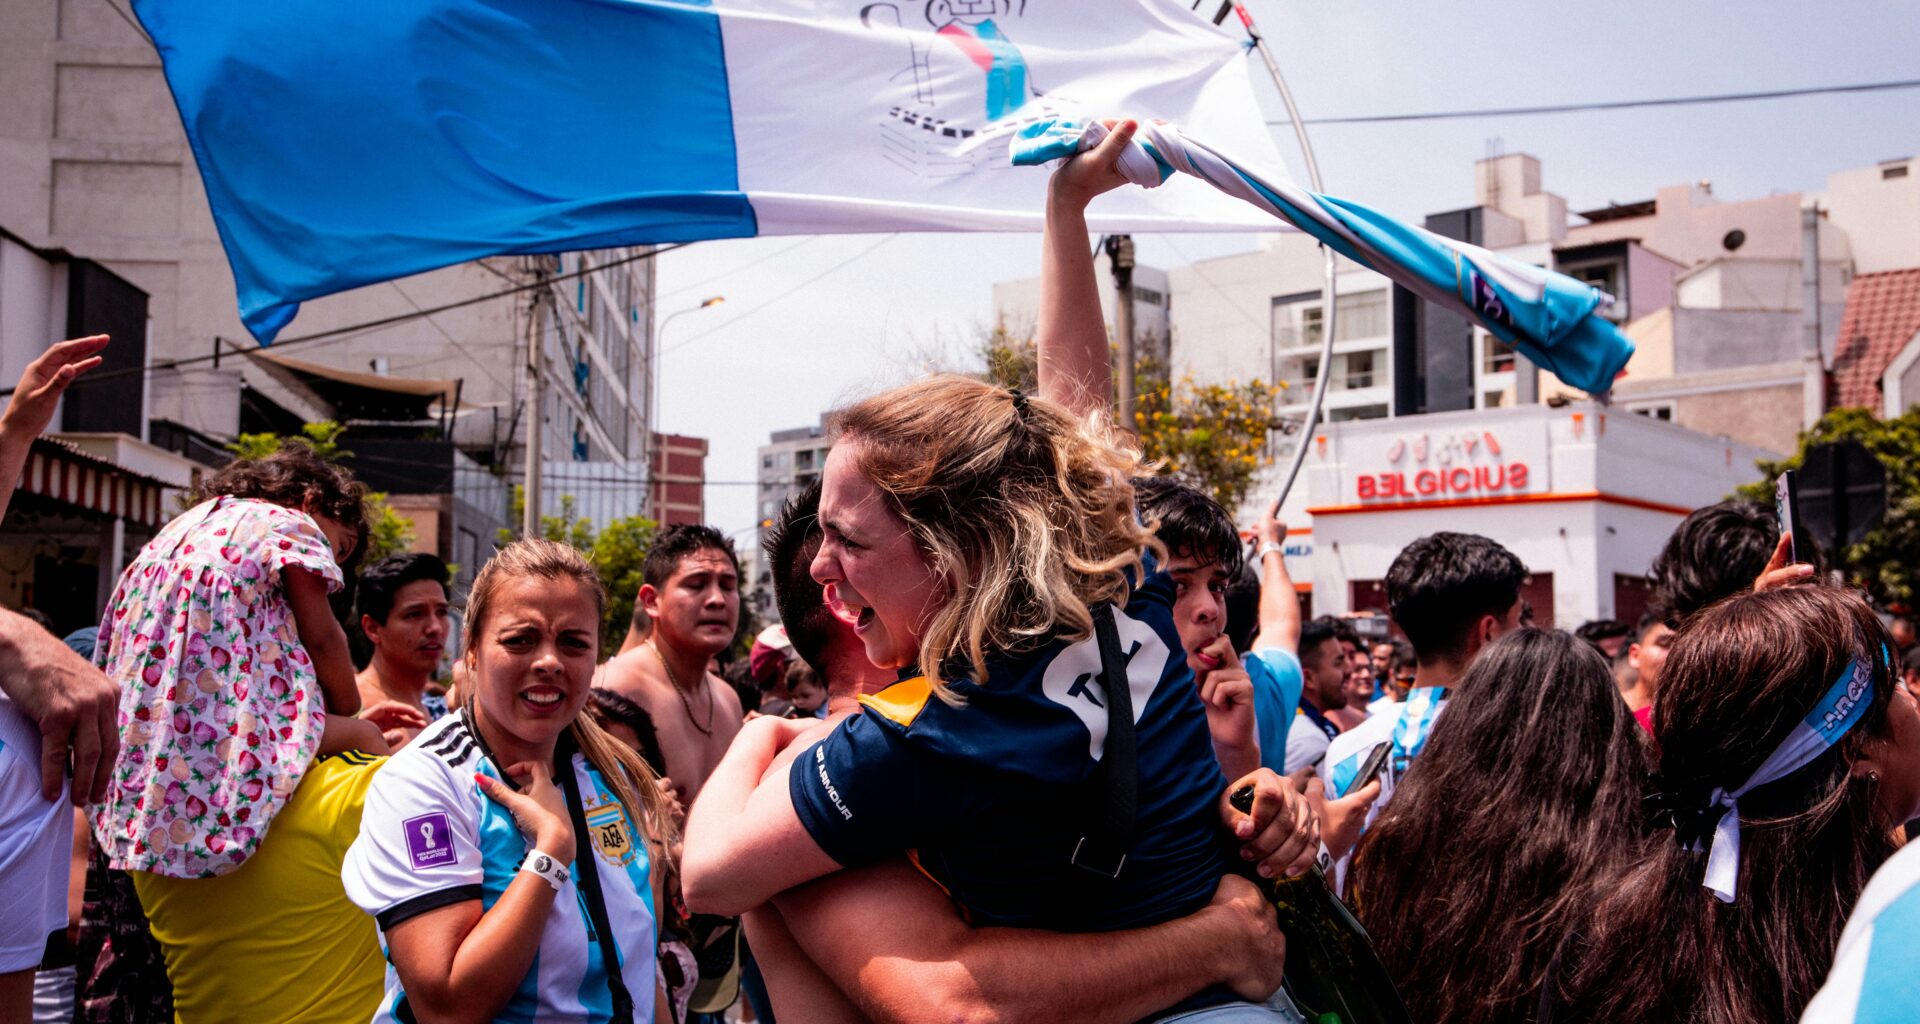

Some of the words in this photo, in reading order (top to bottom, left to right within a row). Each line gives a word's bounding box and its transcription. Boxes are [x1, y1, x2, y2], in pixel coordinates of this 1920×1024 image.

[1357, 463, 1528, 499] BELGICIUS
[818, 764, 853, 820] ARMOUR
[600, 823, 625, 848] AFA
